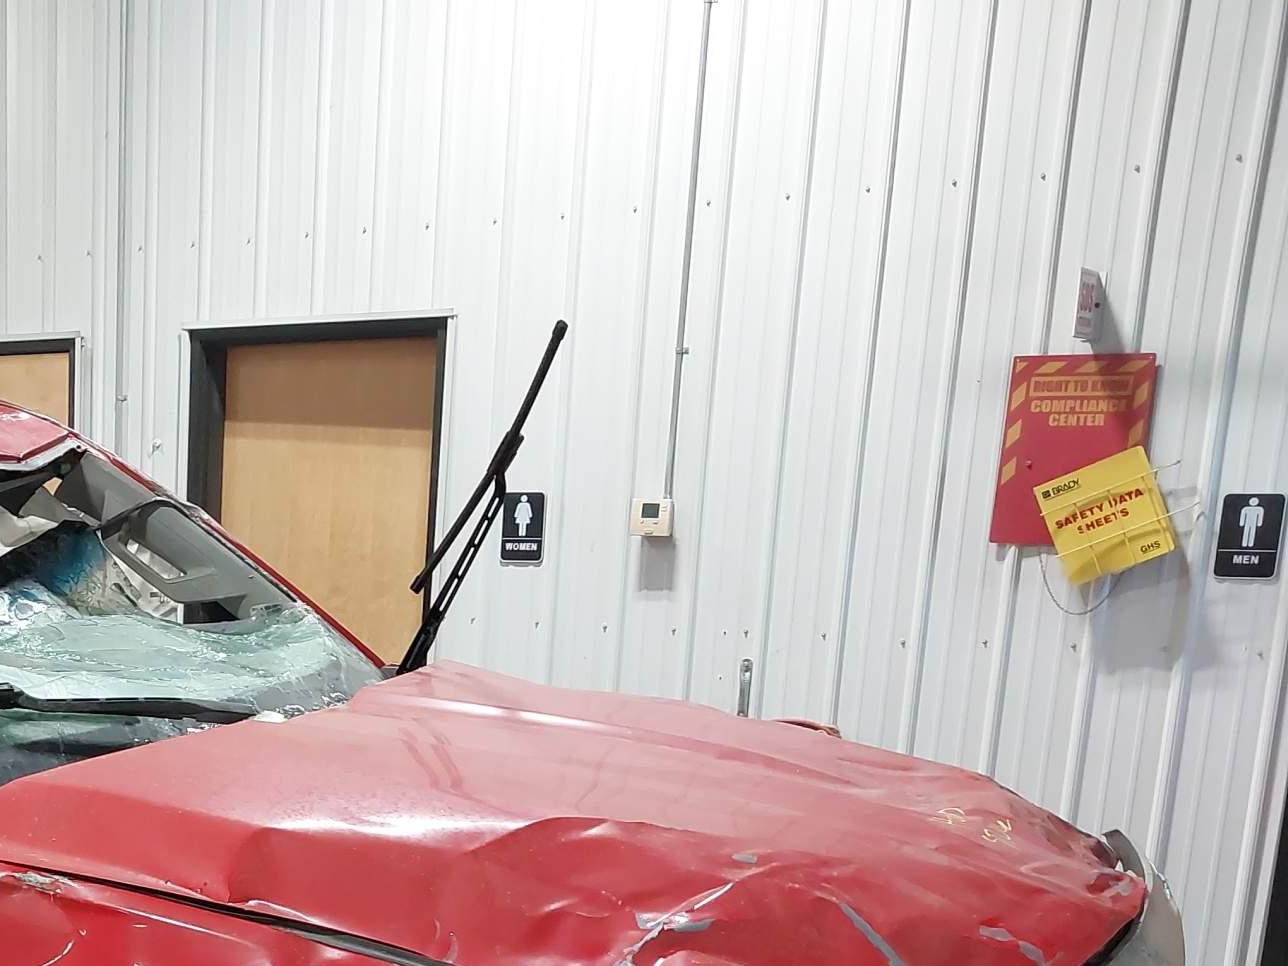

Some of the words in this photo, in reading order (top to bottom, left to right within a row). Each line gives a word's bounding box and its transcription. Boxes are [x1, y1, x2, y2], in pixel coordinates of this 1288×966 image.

[1073, 380, 1088, 393] TO
[1030, 399, 1128, 413] COMPLIANCE
[1048, 413, 1105, 427] CENTER
[1051, 478, 1081, 496] BRADY
[1054, 503, 1105, 530] SAFETY
[1107, 488, 1144, 509] DATA
[1076, 507, 1130, 535] SHEETS
[505, 542, 538, 551] WOMEN
[1139, 540, 1162, 555] GHS
[1232, 554, 1260, 565] MEN
